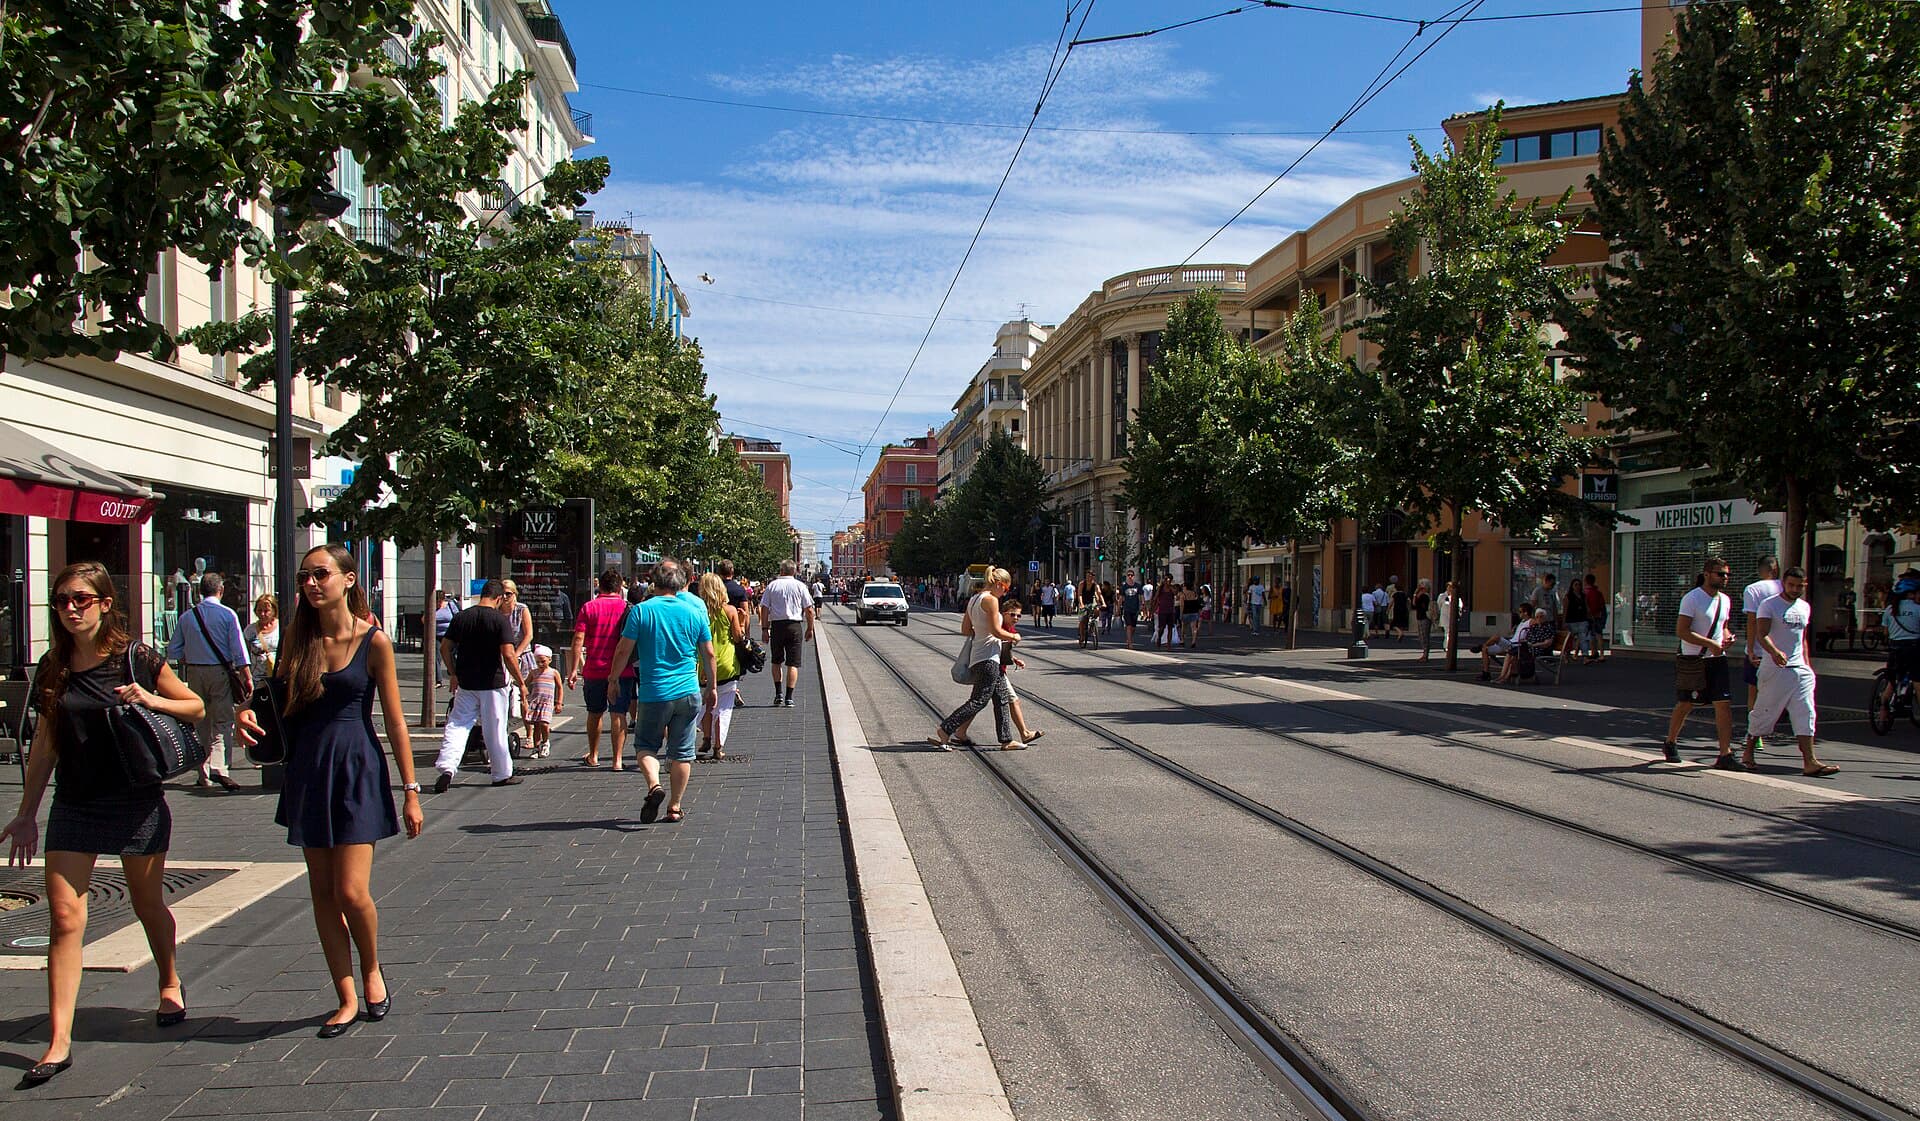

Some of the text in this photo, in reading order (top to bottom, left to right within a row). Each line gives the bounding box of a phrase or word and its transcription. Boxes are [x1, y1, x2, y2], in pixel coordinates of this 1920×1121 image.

[1584, 493, 1617, 501] MEPHISTO
[525, 512, 556, 523] NICE
[1655, 505, 1715, 529] MEPHISTO
[525, 520, 556, 533] JAZZ
